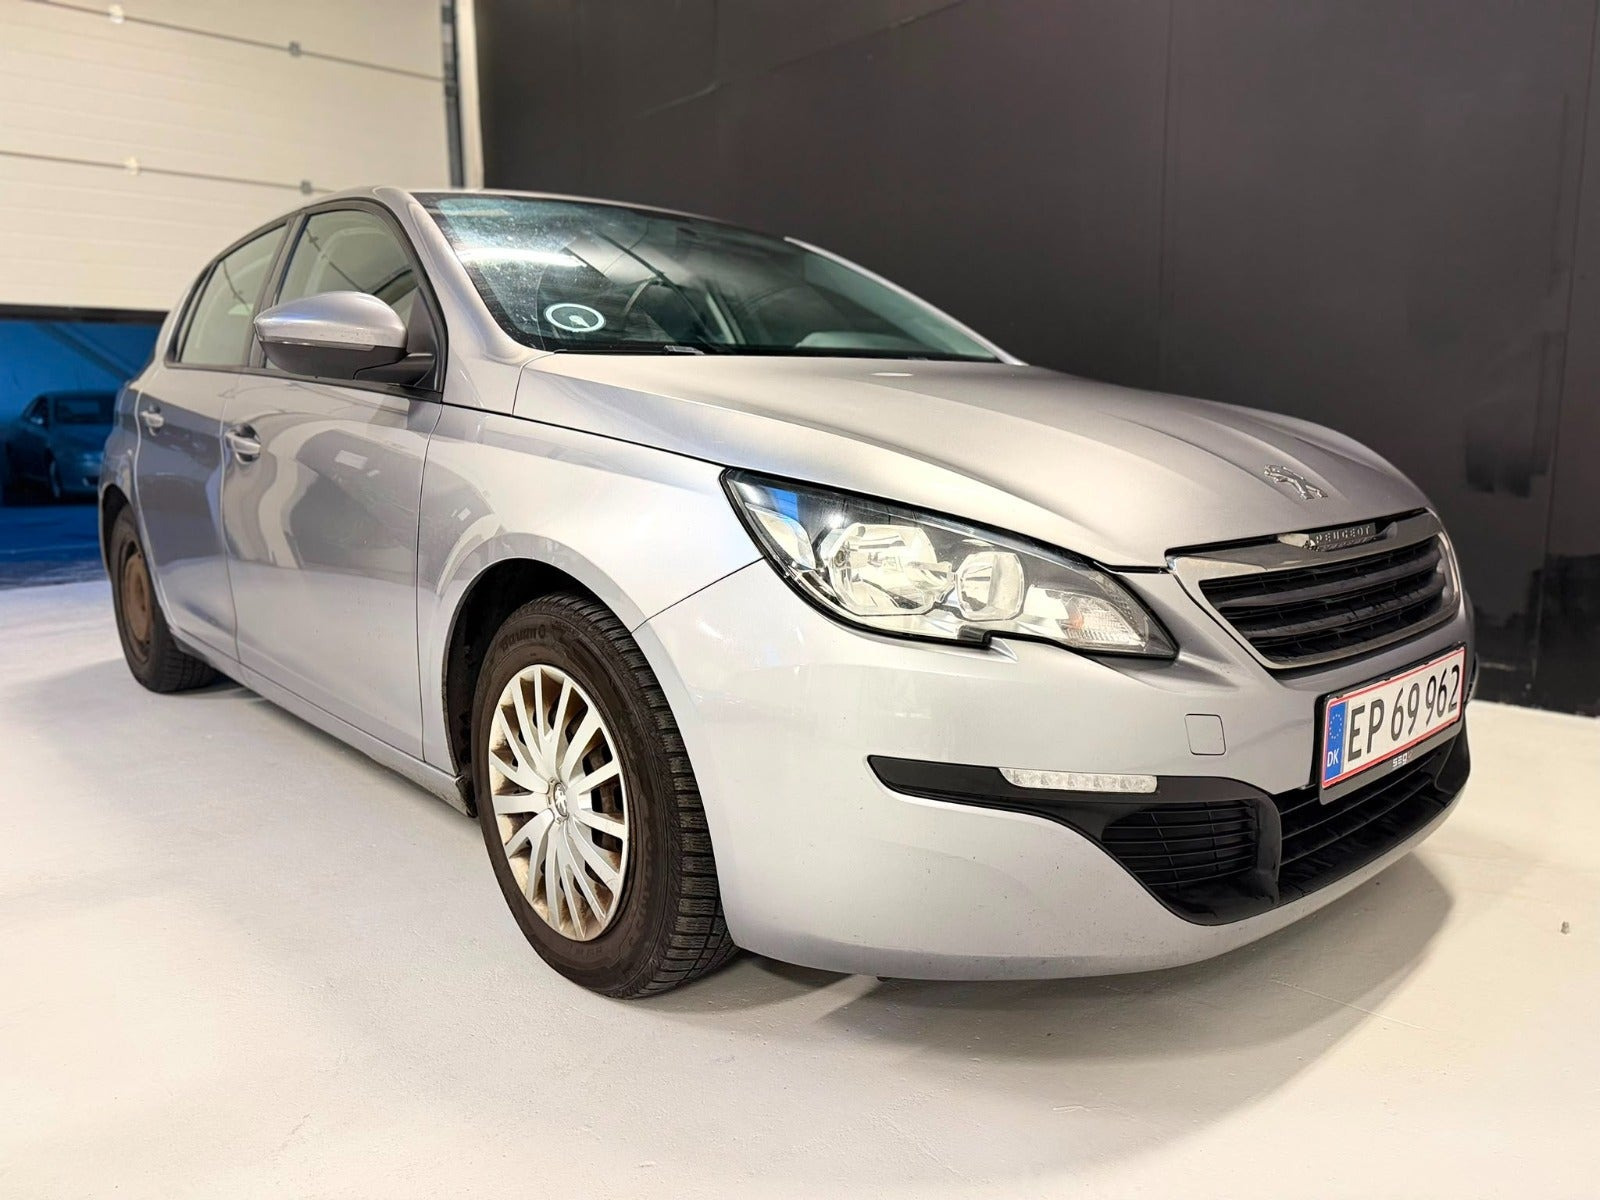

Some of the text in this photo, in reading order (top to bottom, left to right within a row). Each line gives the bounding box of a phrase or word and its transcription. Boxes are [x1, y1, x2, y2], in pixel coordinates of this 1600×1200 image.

[1315, 525, 1371, 544] PEUGEOT
[1347, 664, 1460, 762] EP 69 962
[1326, 749, 1340, 767] DK
